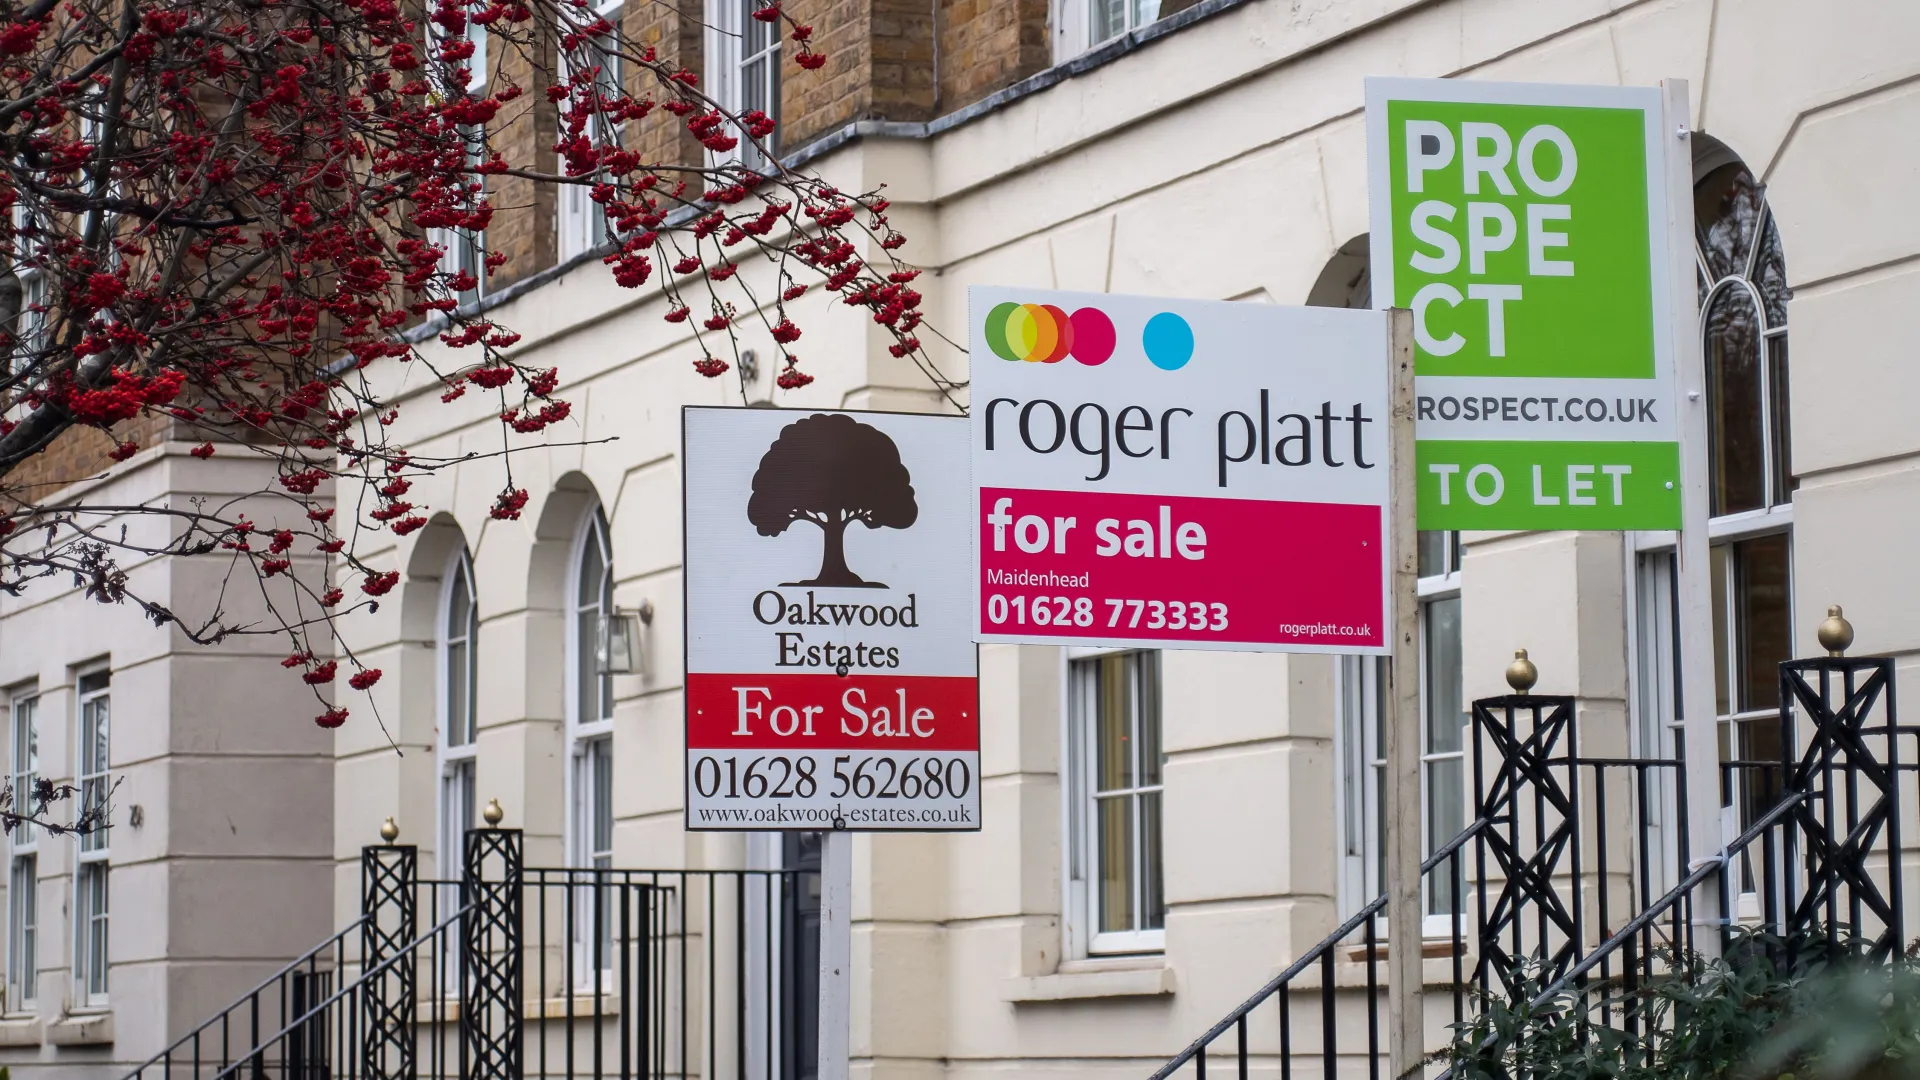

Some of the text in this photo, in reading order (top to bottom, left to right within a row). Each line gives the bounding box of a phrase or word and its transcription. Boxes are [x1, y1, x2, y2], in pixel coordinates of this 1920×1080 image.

[1405, 120, 1578, 197] PRO
[1409, 200, 1575, 277] SPE
[1414, 283, 1523, 357] CT
[1417, 396, 1658, 423] ROSPECT.CO.UK
[984, 388, 1376, 488] roger platt
[1429, 463, 1632, 506] TO LET
[987, 497, 1208, 561] for sale
[987, 568, 1089, 588] Maidenhead
[752, 590, 919, 628] Oakwood
[987, 593, 1229, 632] 01628 773333
[1279, 621, 1371, 637] rogerplatt.co.uk
[775, 632, 900, 668] Estates
[731, 686, 935, 738] For Sale
[694, 754, 971, 800] 01628 562680
[699, 803, 972, 825] www.oakwood-estates.co.uk
